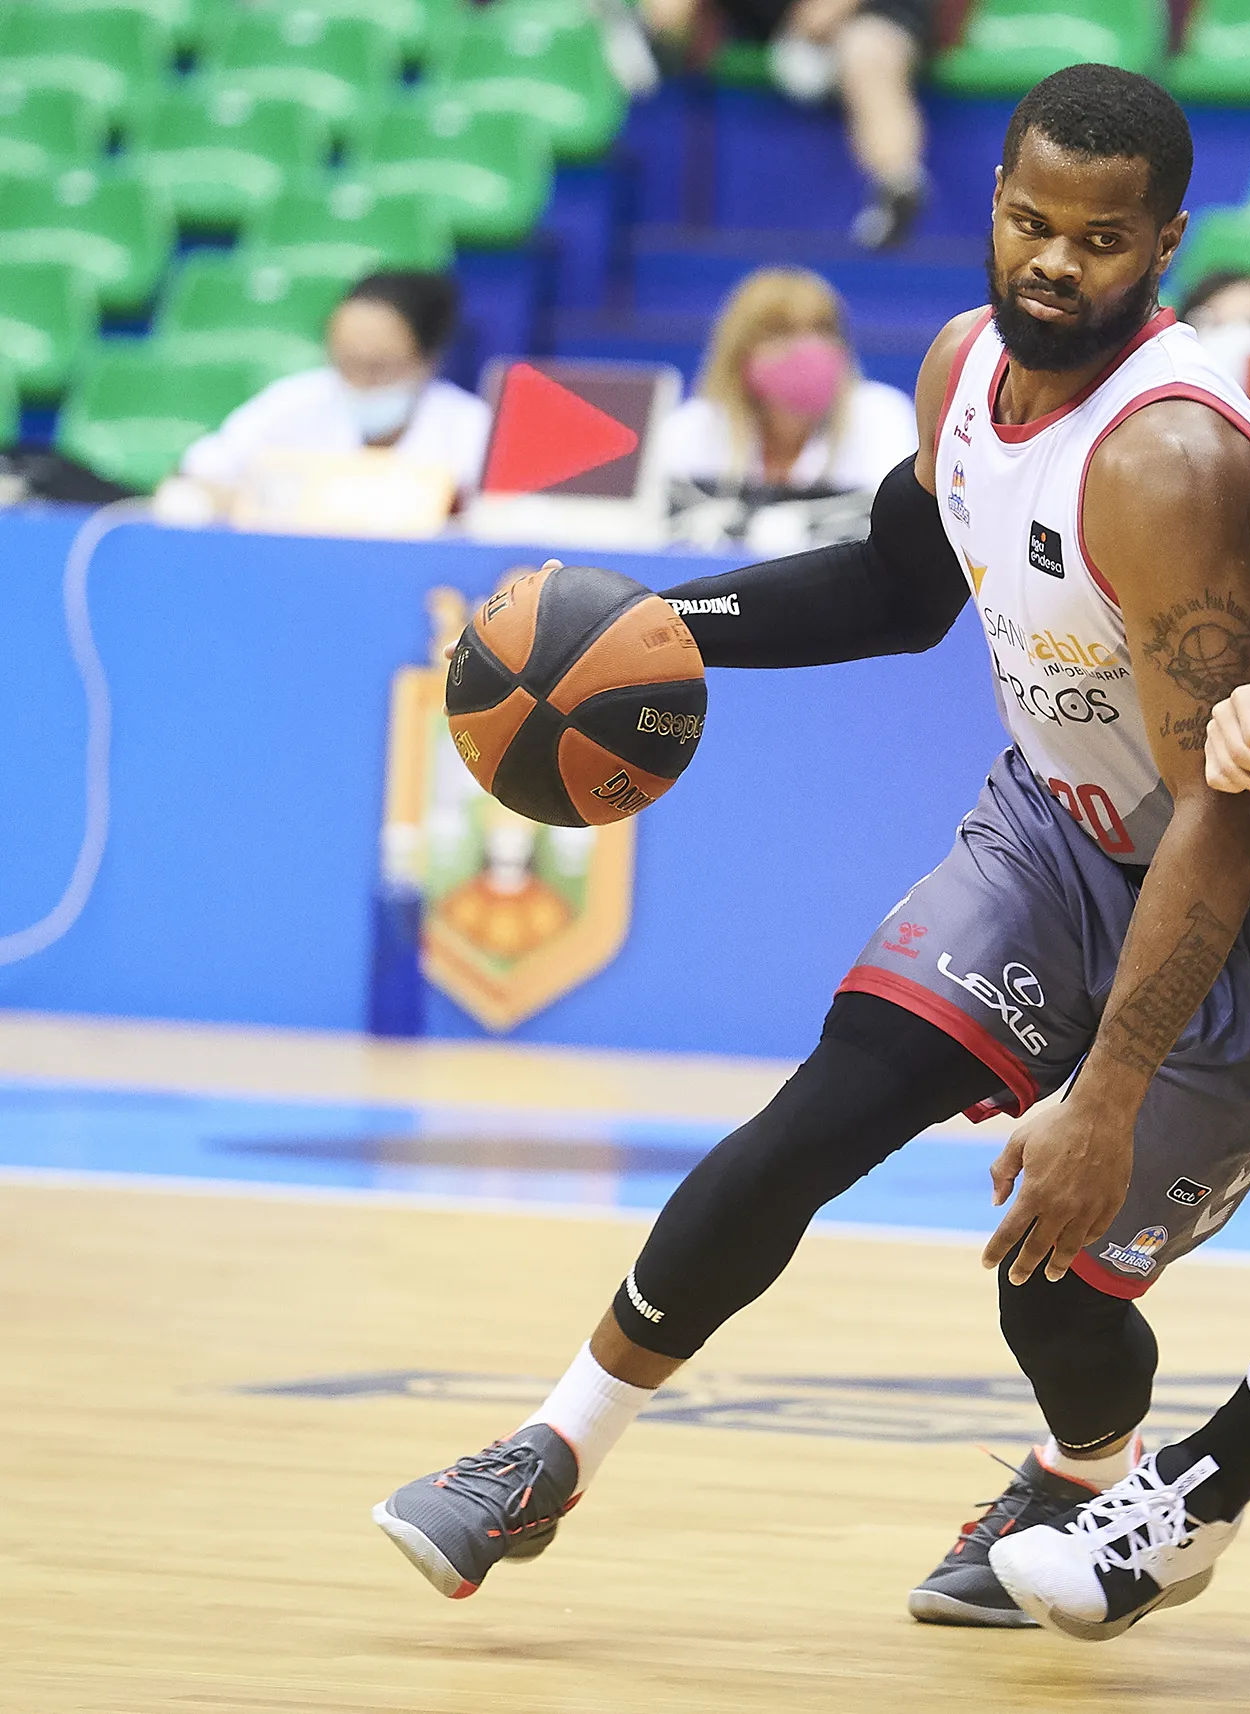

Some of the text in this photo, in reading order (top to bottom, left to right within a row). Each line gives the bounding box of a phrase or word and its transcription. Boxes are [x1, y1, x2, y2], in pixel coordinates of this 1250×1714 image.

[1031, 534, 1045, 553] liga
[1030, 551, 1063, 574] endesa
[984, 608, 1025, 650] SAN
[937, 951, 1049, 1056] LEXUS
[1173, 1188, 1196, 1203] acb
[1109, 1249, 1152, 1271] BURGOS
